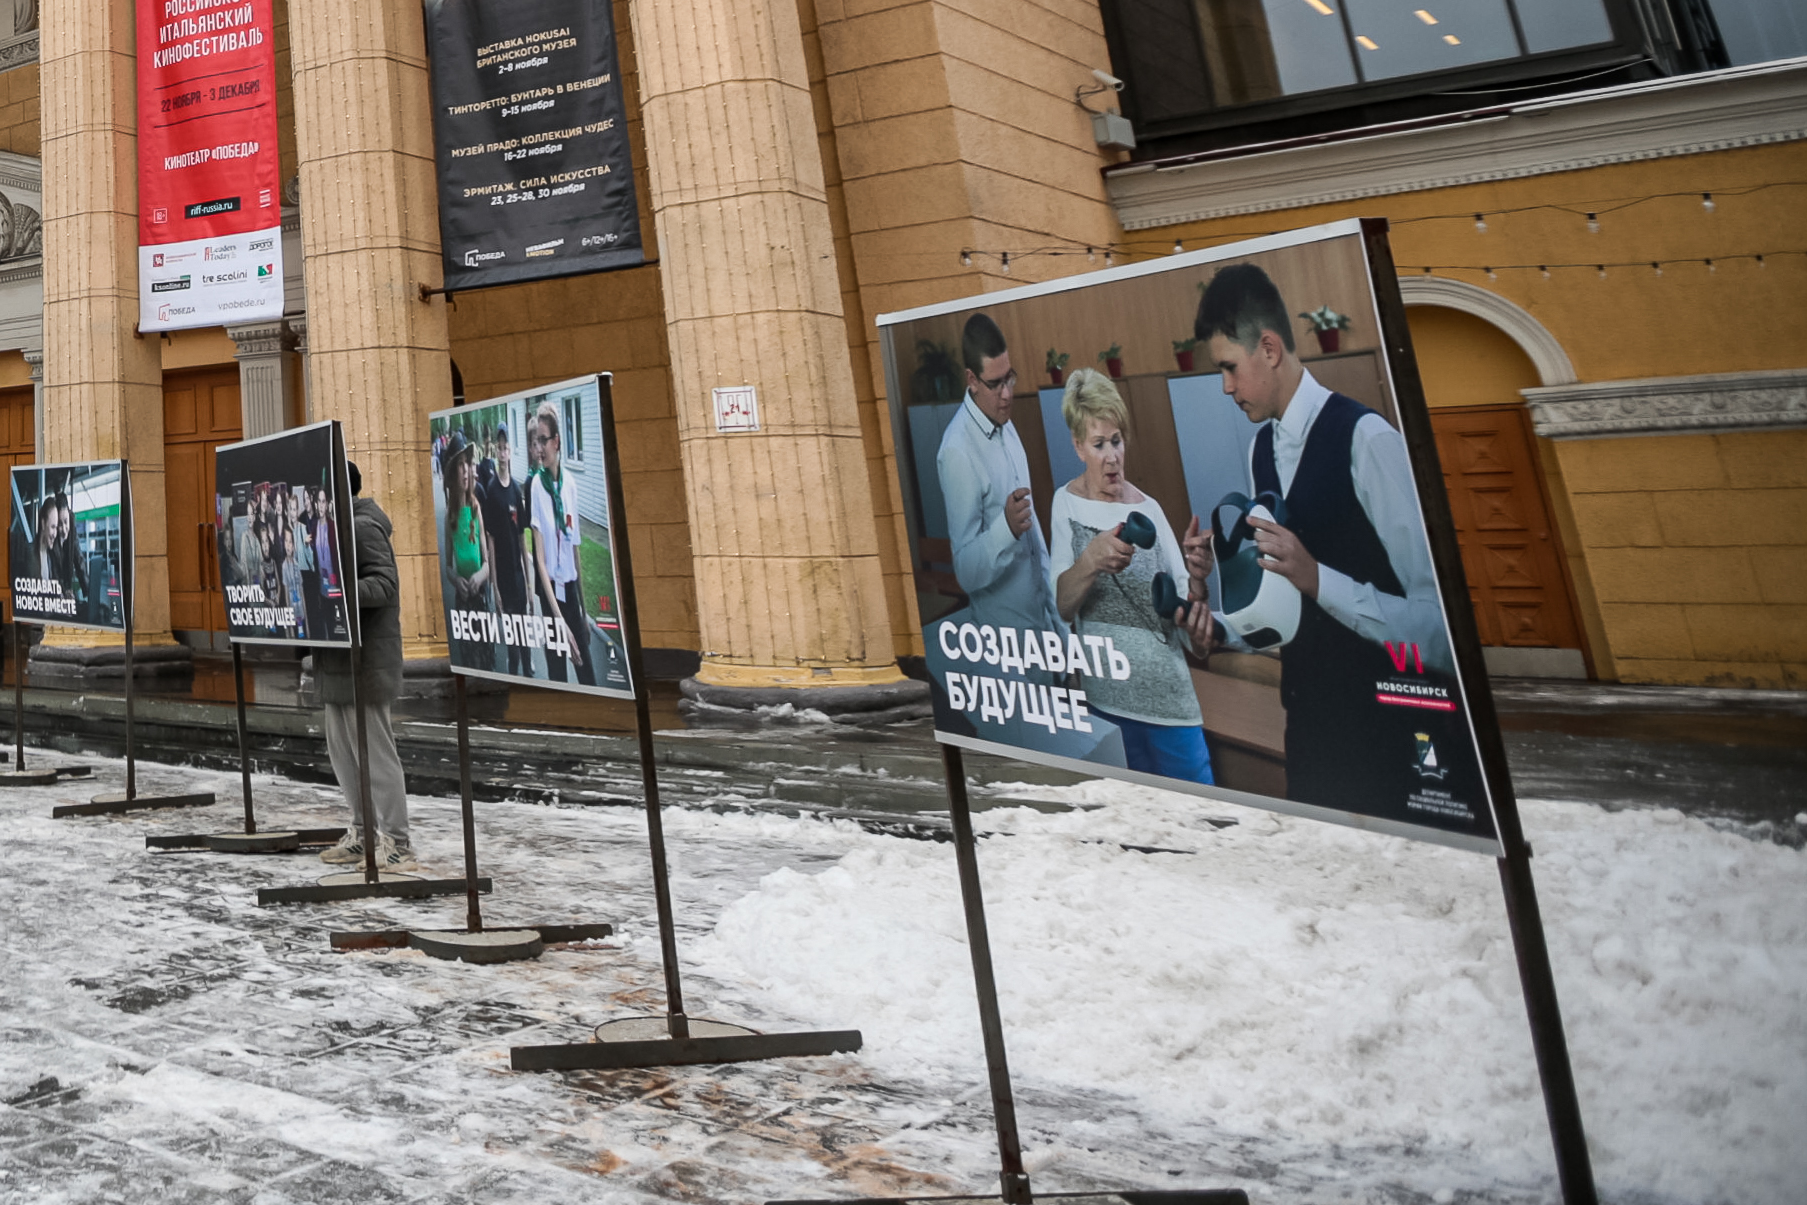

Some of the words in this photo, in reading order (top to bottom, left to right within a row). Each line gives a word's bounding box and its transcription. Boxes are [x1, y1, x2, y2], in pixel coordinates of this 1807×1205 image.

[159, 2, 253, 44] ИТАЛЬЯНСКИЙ
[153, 27, 263, 69] КИНОФЕСТИВАЛЬ
[476, 37, 524, 57] ВЫСТАВКА
[525, 27, 570, 44] HOKUSAI
[476, 45, 540, 69] БРИТАНСКОГО
[542, 37, 577, 52] МУЗЕЯ
[515, 56, 549, 70] ноября
[161, 99, 171, 112] 22
[172, 91, 202, 110] НОЯБРЯ
[209, 88, 216, 101] 3
[218, 79, 260, 101] ДЕКАБРЯ
[448, 97, 510, 116] ТИНТОРЕТТО:
[511, 88, 555, 104] БУНТАРЬ
[556, 84, 564, 94] В
[566, 73, 611, 92] ВЕНЕЦИИ
[521, 99, 555, 113] ноября
[451, 144, 485, 158] МУЗЕЙ
[486, 139, 520, 151] ПРАДО:
[521, 126, 582, 146] КОЛЛЕКЦИЯ
[584, 118, 614, 133] ЧУДЕС
[528, 143, 563, 157] ноября
[164, 148, 211, 171] КИНОТЕАТР
[211, 141, 260, 160] «ПОБЕДА»
[463, 181, 517, 198] ЭРМИТАЖ.
[519, 176, 547, 189] СИЛА
[550, 164, 611, 183] ИСКУССТВА
[490, 195, 504, 206] 23,
[537, 188, 550, 199] 30
[551, 182, 585, 196] ноября
[190, 202, 233, 216] riff-russia.ru
[475, 250, 506, 261] ПОБЕДА
[168, 307, 196, 316] ПОБЕДА
[218, 299, 266, 310] vpobede.ru
[15, 577, 62, 595] СОЗДАВАТЬ
[226, 584, 266, 603] ТВОРИТЬ
[15, 595, 43, 611] НОВОЕ
[44, 597, 77, 614] ВМЕСТЕ
[230, 608, 254, 626] СВОЕ
[254, 607, 296, 629] БУДУЩЕЕ
[450, 609, 501, 644] ВЕСТИ
[501, 613, 572, 658] ВПЕРЕД
[938, 620, 1131, 681] СОЗДАВАТЬ
[1376, 681, 1448, 697] НОВОСИБИРСК
[945, 671, 1093, 734] БУДУЩЕЕ
